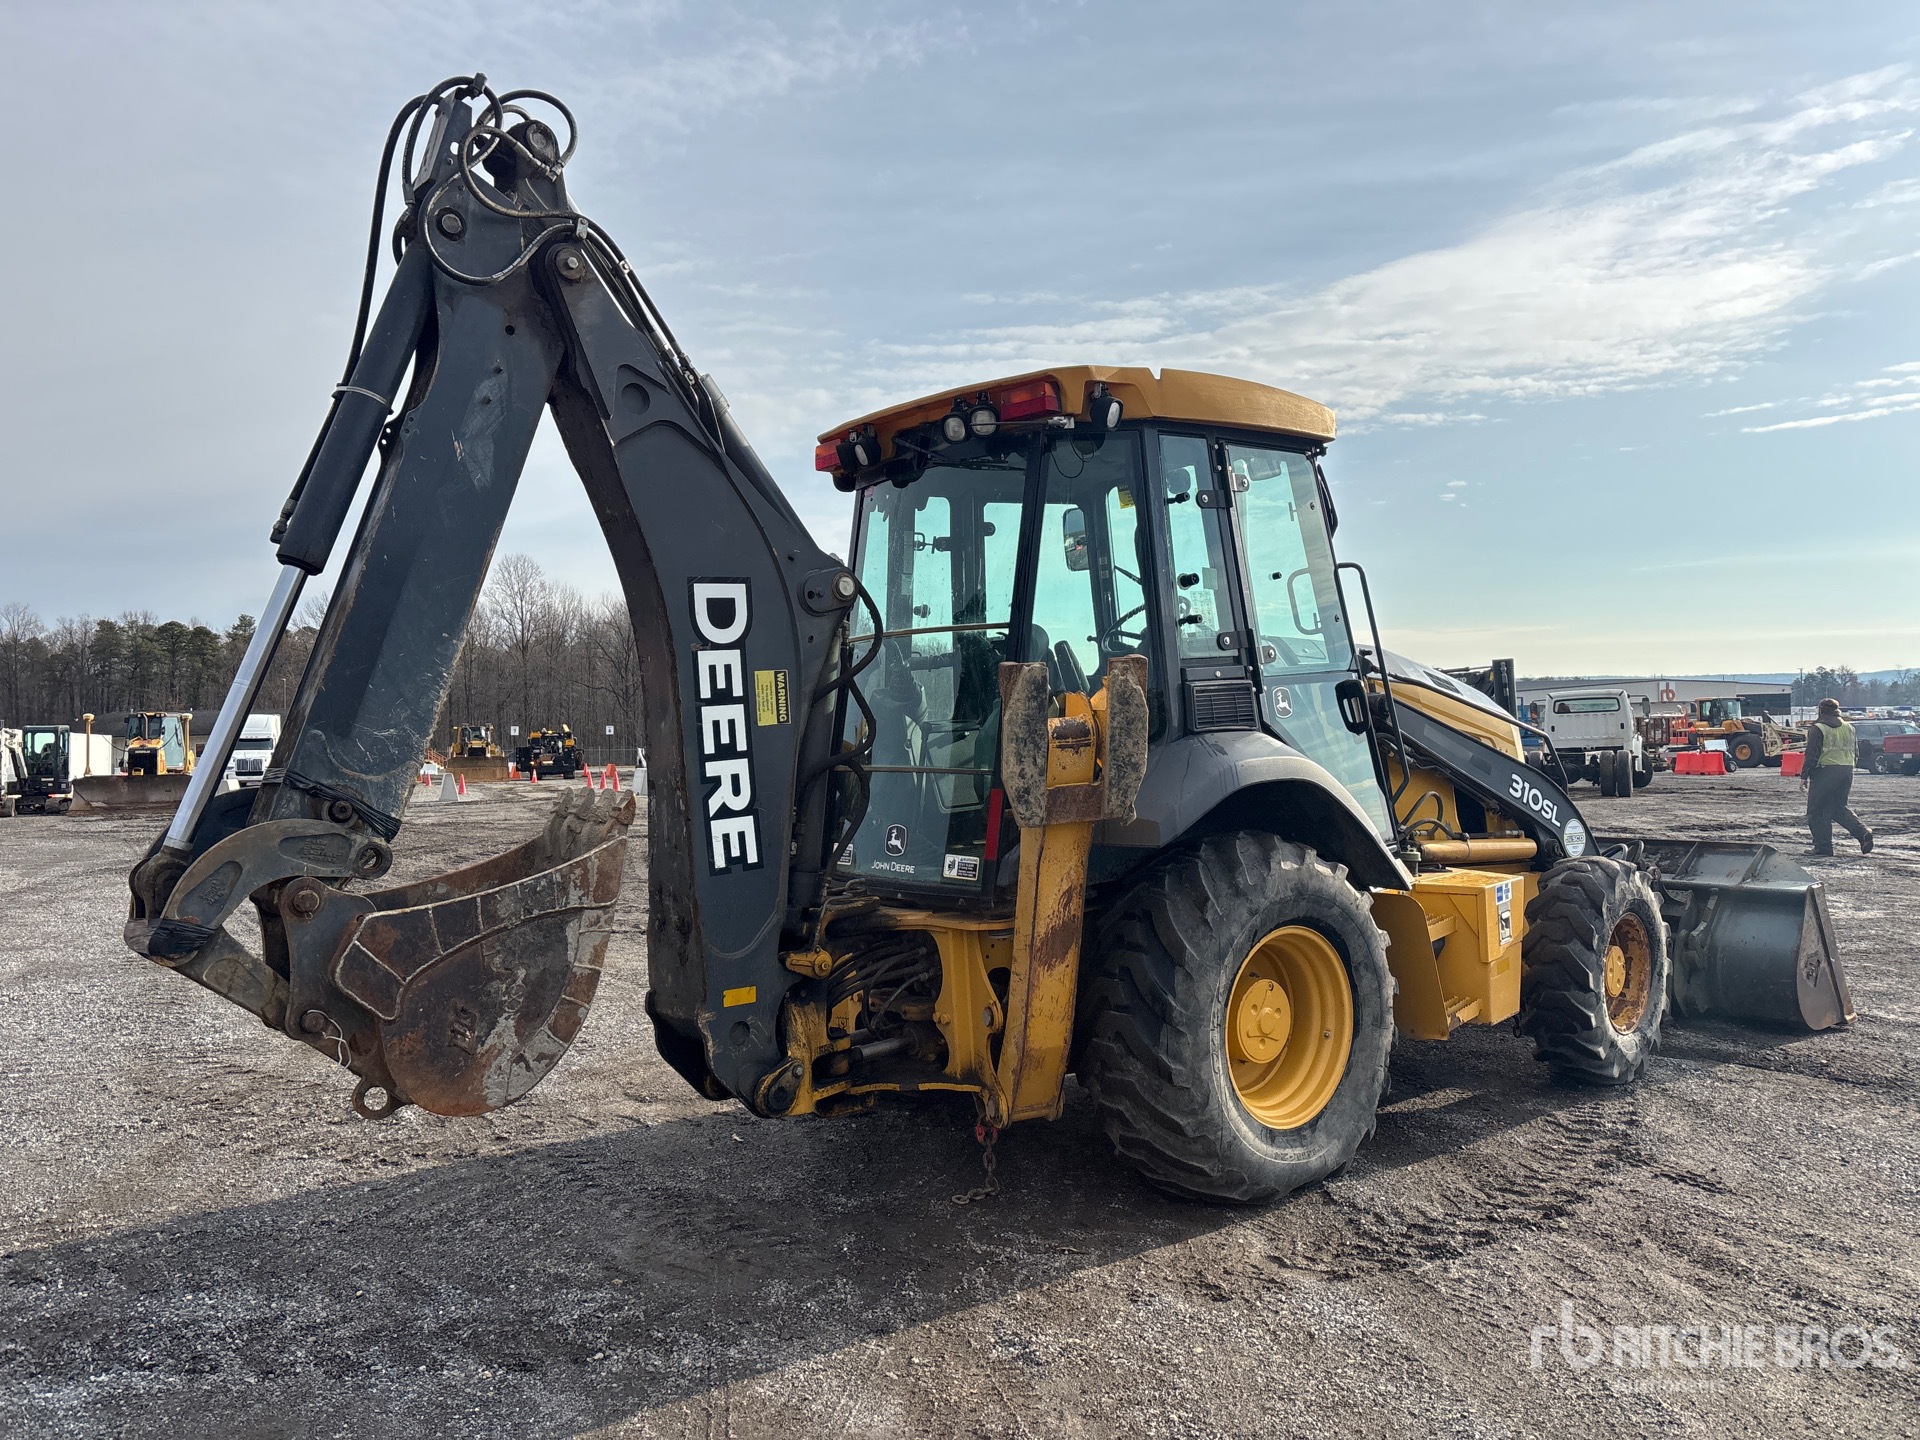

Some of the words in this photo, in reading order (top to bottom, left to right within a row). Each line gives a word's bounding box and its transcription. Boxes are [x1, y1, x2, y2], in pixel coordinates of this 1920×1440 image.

[776, 672, 787, 722] WARNING
[693, 583, 758, 869] DEERE
[1509, 773, 1560, 828] 310SL
[871, 860, 890, 870] JOHN
[890, 861, 915, 874] DEERE
